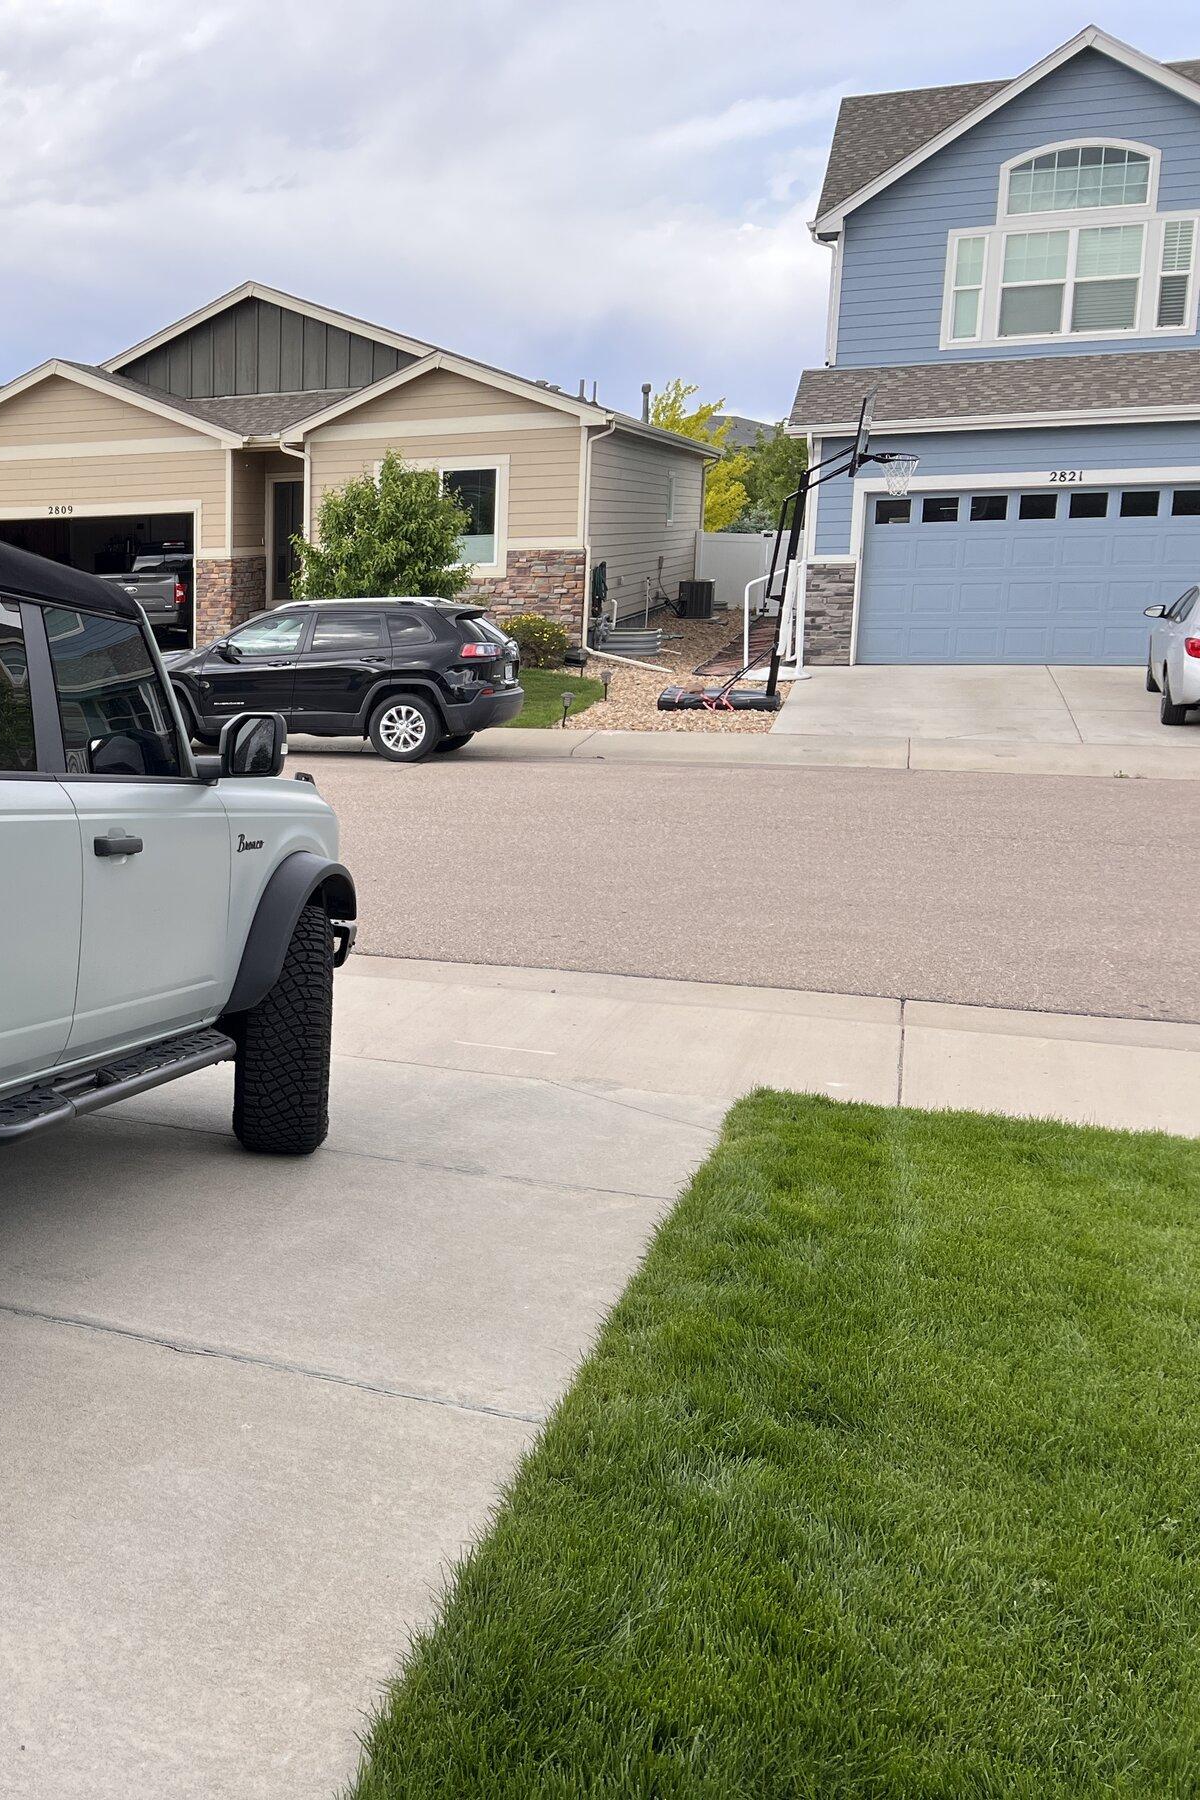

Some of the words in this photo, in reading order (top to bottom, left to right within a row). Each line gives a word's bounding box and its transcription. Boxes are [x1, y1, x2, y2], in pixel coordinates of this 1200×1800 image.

[1049, 470, 1083, 482] 2821
[48, 505, 73, 514] 2809
[237, 833, 264, 853] Bronco
